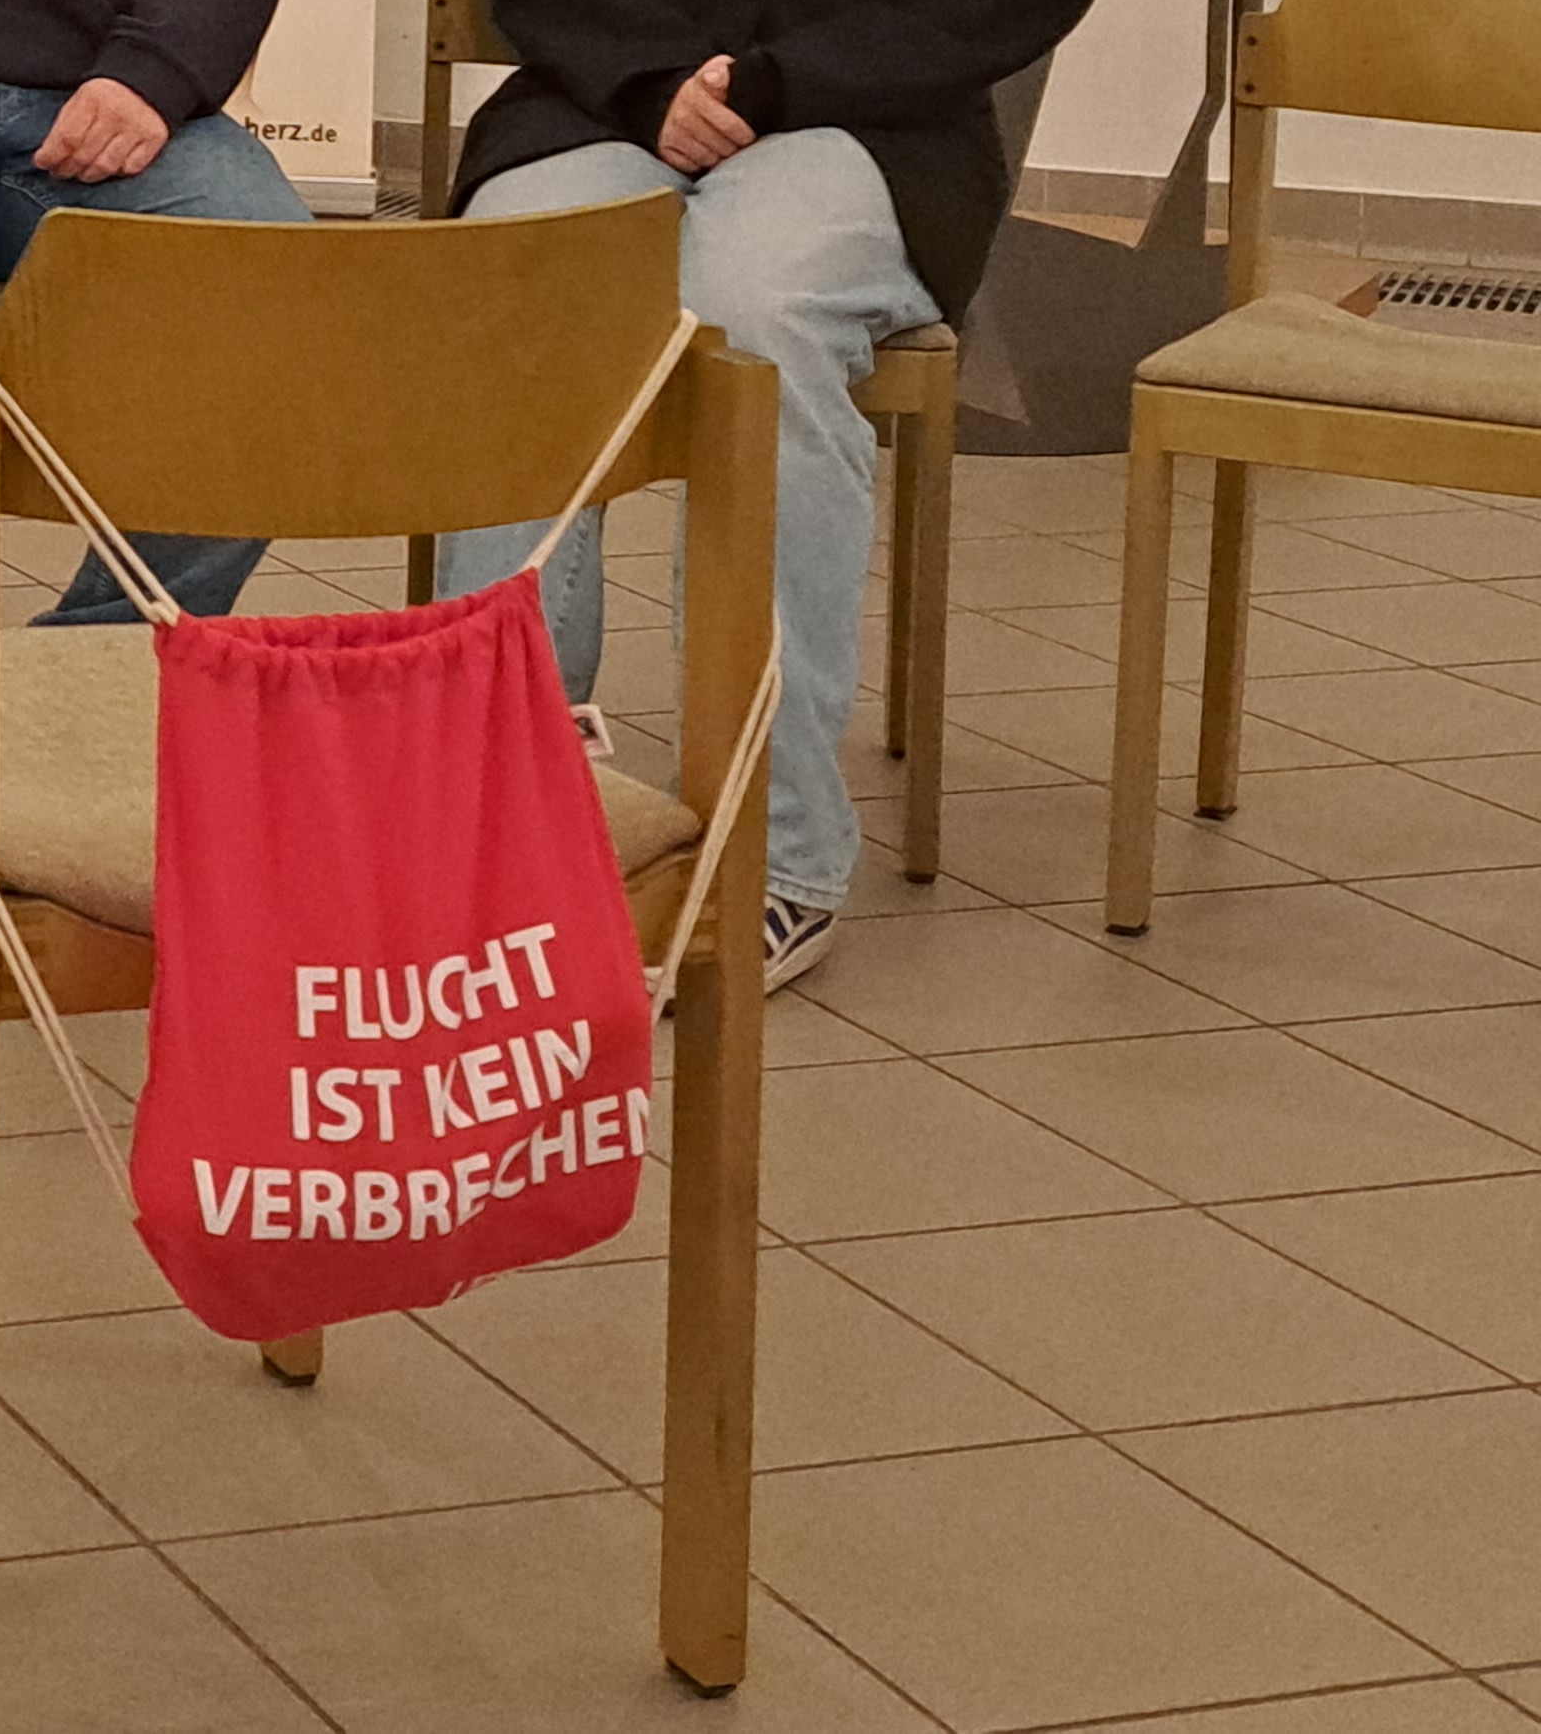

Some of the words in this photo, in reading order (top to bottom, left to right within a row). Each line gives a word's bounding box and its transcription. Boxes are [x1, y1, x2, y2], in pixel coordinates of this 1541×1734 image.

[296, 922, 557, 1040] FLUCHT
[290, 1067, 403, 1142] IST
[423, 1020, 593, 1138] KEIN
